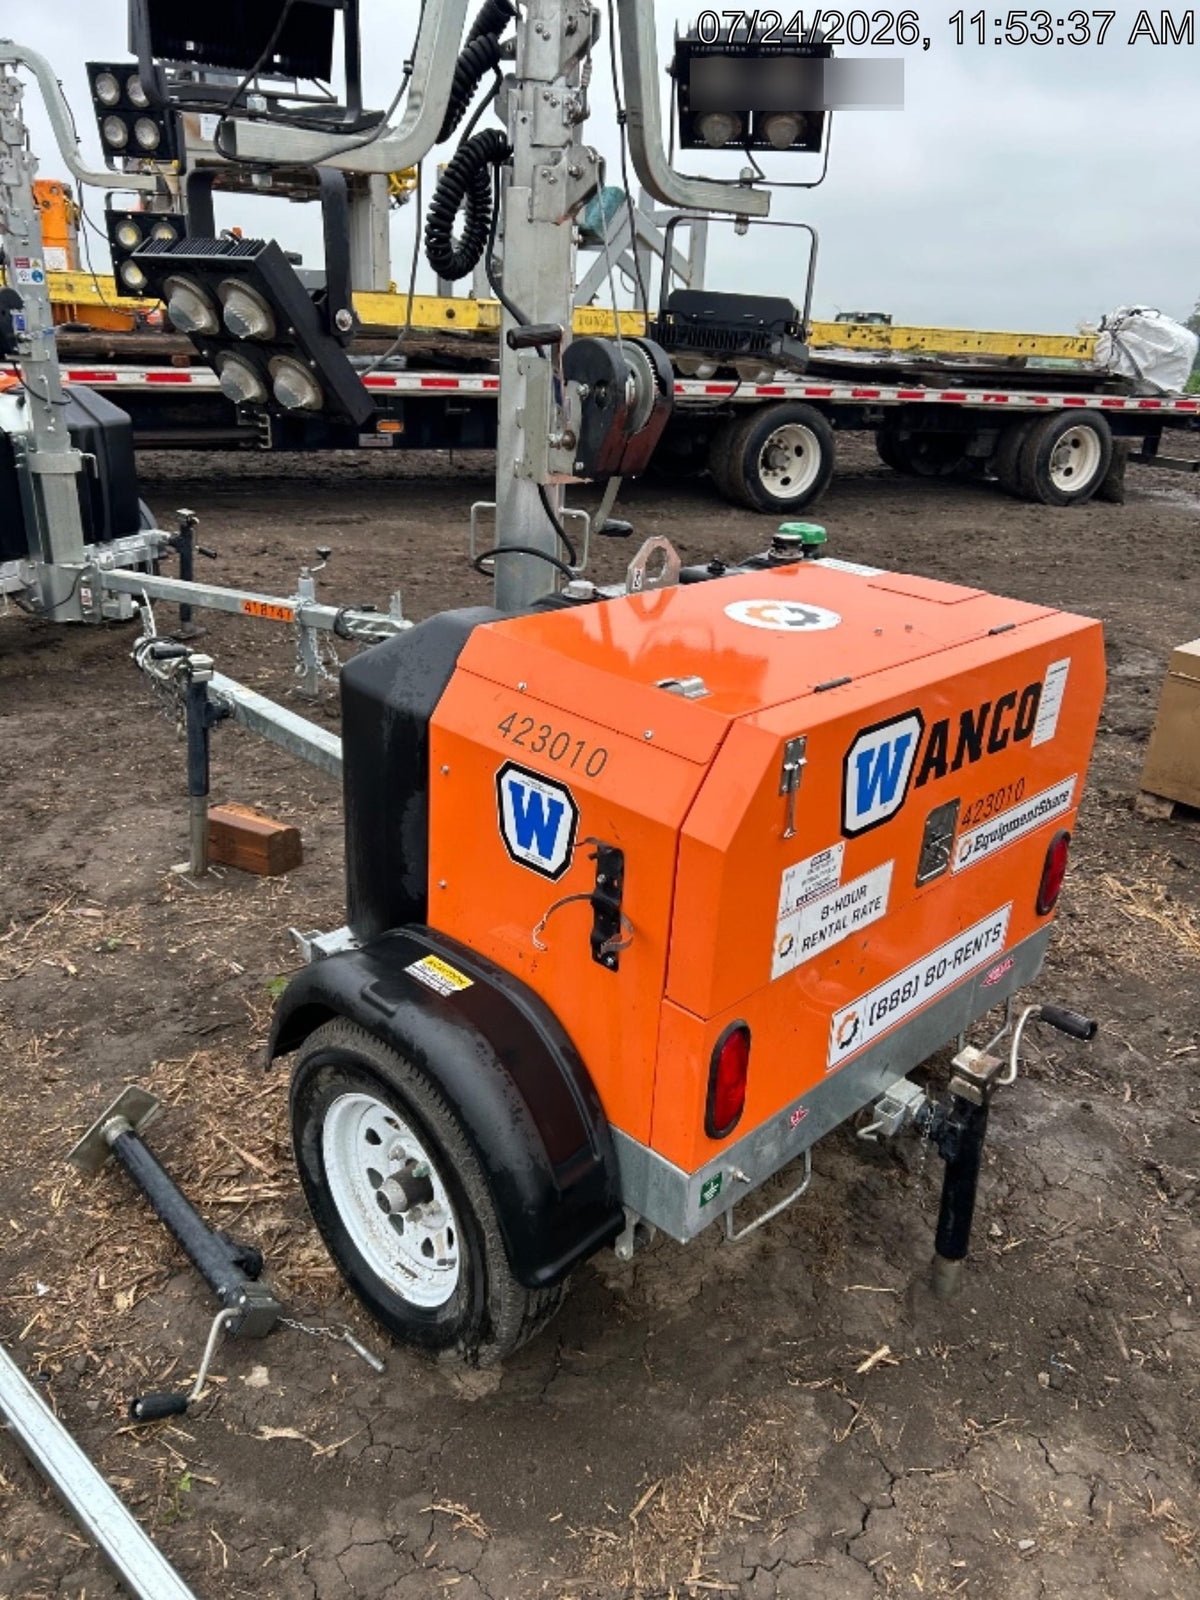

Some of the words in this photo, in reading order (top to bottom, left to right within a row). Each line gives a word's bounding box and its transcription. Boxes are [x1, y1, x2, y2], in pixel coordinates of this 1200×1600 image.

[497, 711, 609, 778] 423010
[855, 681, 1043, 816] WANCO
[508, 779, 565, 862] W
[961, 777, 1025, 826] 423010
[974, 790, 1070, 852] EquipmentShare
[801, 915, 849, 952] RENTAL
[852, 895, 883, 923] RATE
[821, 884, 868, 920] 8-HOUR
[868, 974, 920, 1026] (888)
[923, 922, 1002, 987] 80-RENTS
